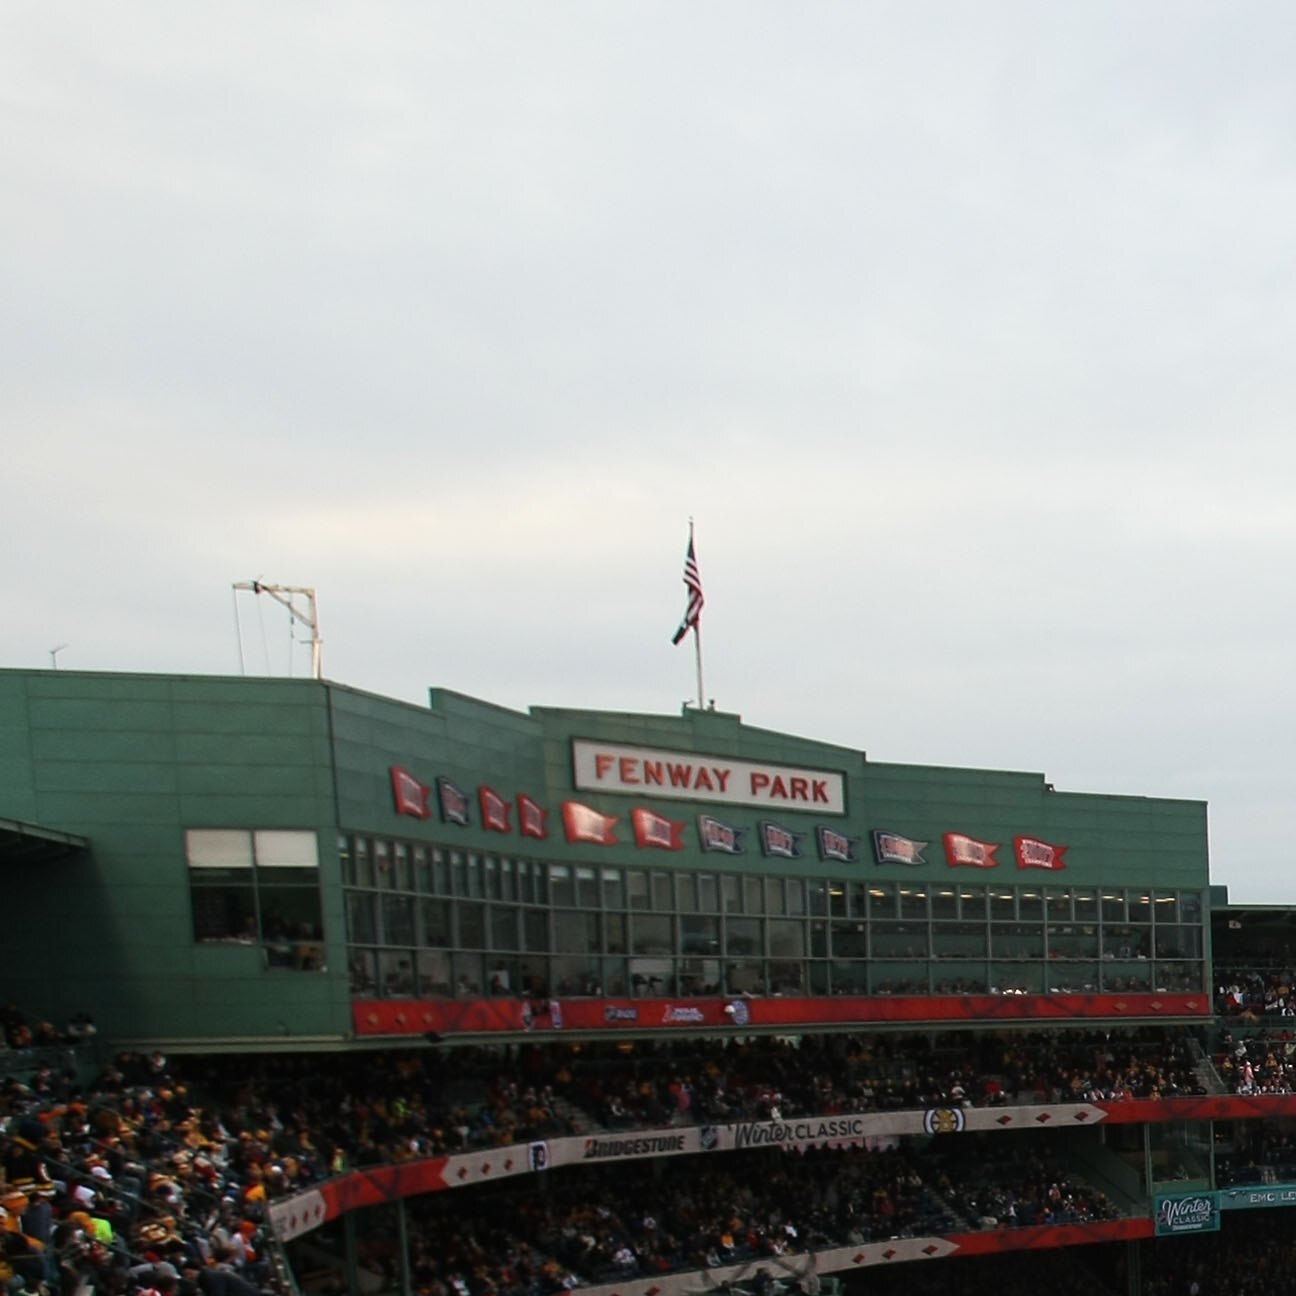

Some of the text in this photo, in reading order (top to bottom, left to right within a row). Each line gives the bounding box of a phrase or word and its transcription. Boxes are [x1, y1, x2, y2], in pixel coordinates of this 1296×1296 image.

[596, 754, 830, 803] FENWAY PARK
[584, 1119, 862, 1159] BRIDGESTONE Winter CLASSIC
[1161, 1197, 1212, 1226] Winter
[1250, 1192, 1275, 1203] EMC
